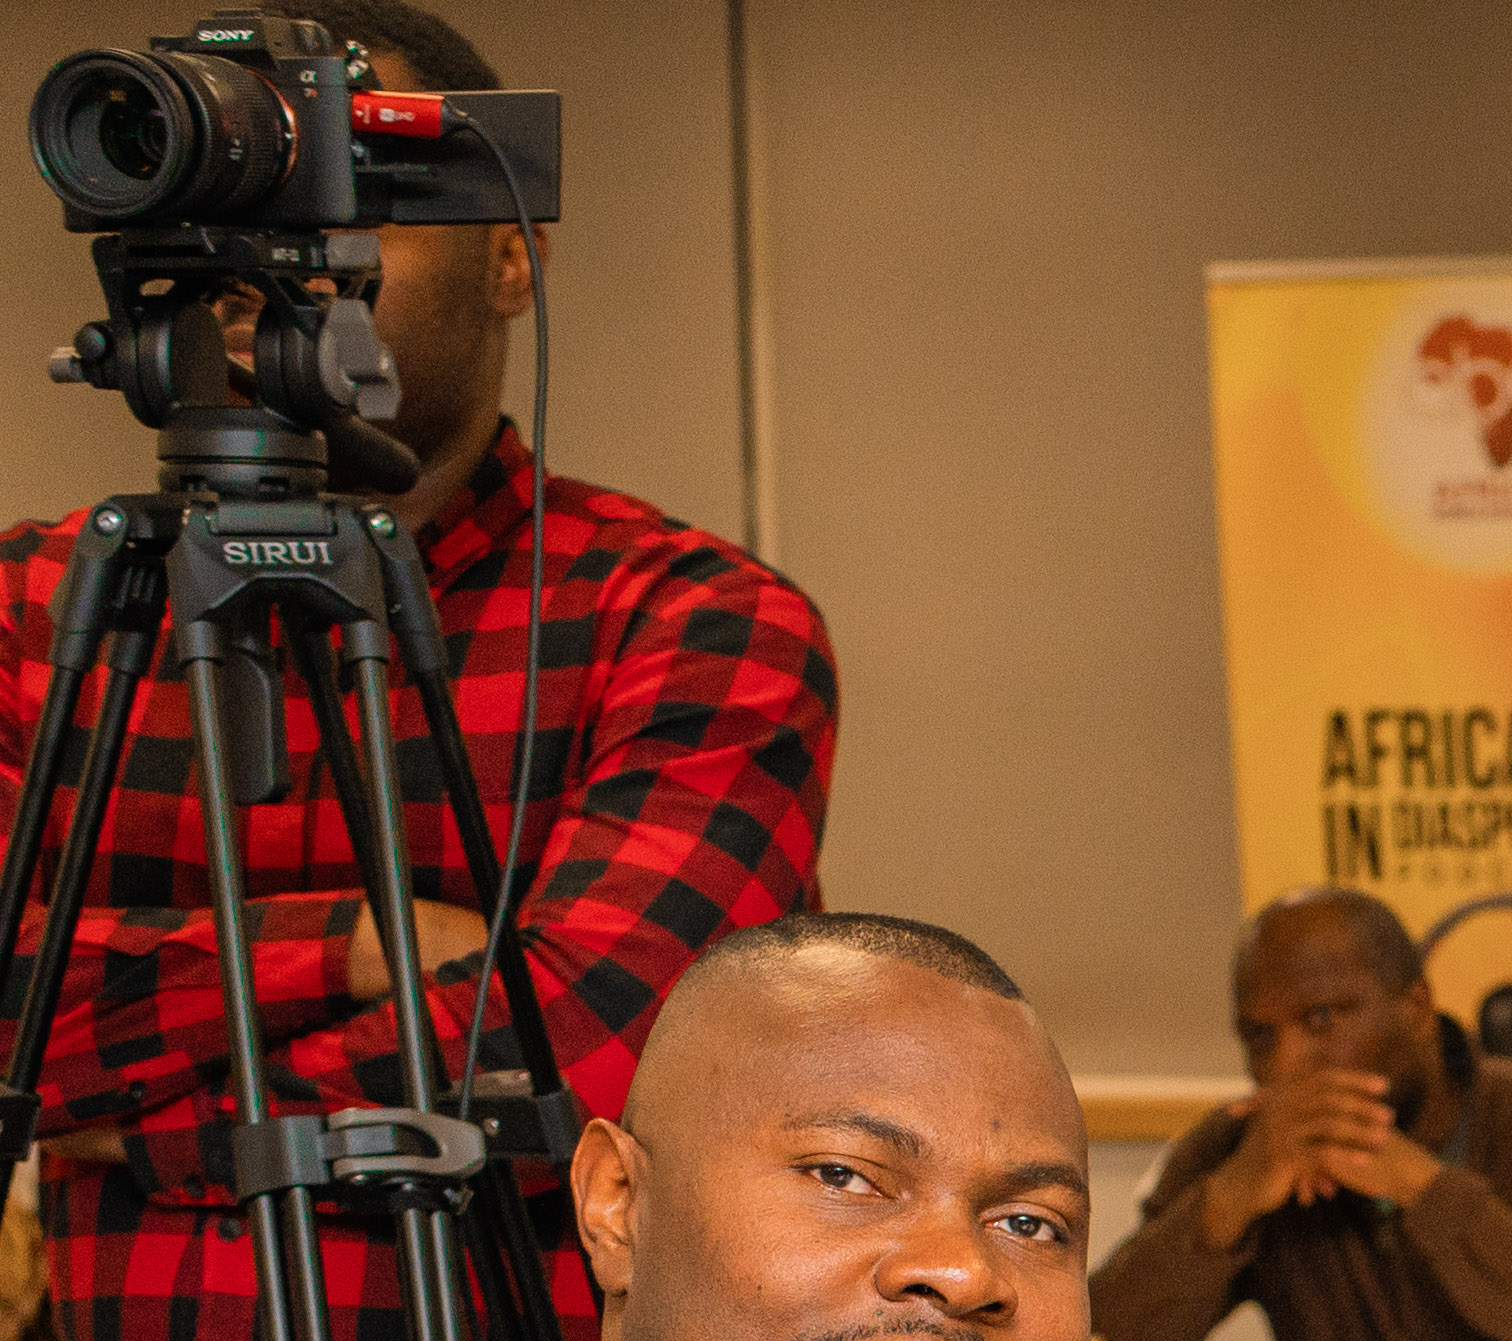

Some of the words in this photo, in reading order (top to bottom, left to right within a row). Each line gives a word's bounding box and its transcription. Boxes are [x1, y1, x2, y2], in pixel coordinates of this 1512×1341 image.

[197, 29, 255, 43] SONY
[223, 541, 332, 565] SIRUI
[1324, 800, 1383, 882] IN
